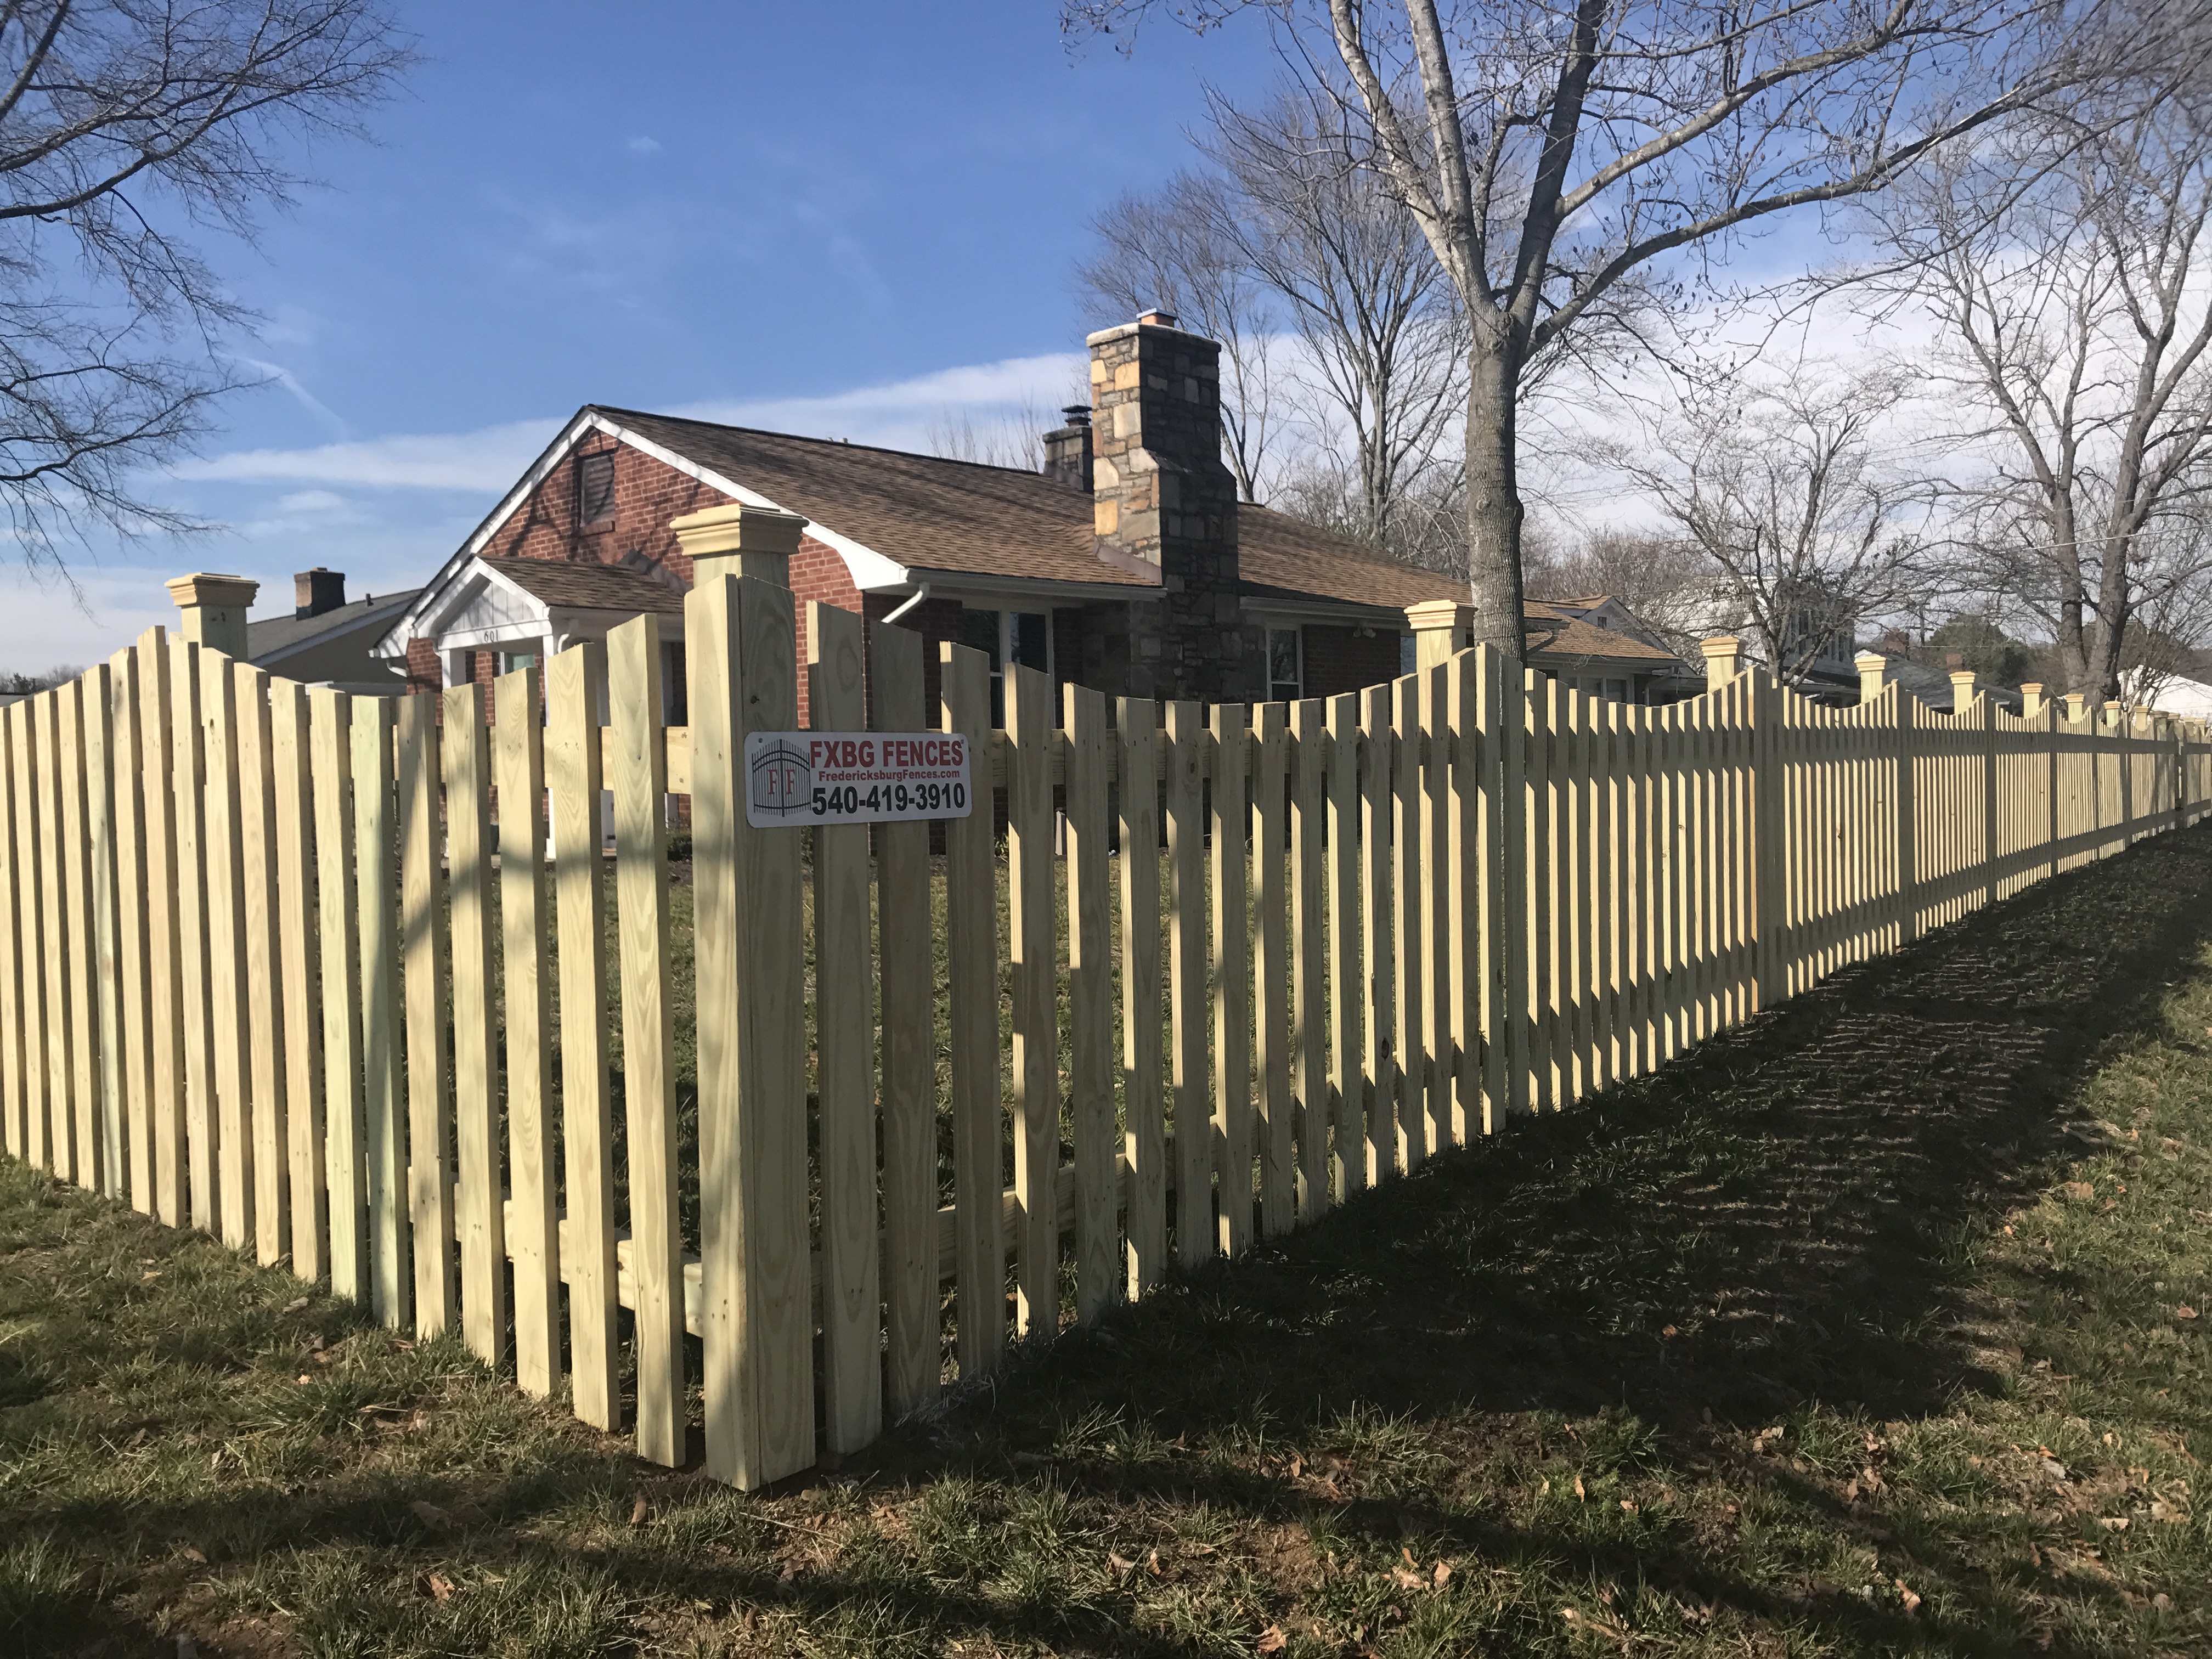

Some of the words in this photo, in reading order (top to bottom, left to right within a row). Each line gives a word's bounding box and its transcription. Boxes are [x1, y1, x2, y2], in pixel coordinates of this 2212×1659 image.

[484, 629, 498, 643] 601
[810, 741, 874, 768] FXBG
[883, 740, 963, 767] FENCES
[819, 769, 960, 782] FredericksburgFences.com
[811, 783, 965, 815] 540-419-3910
